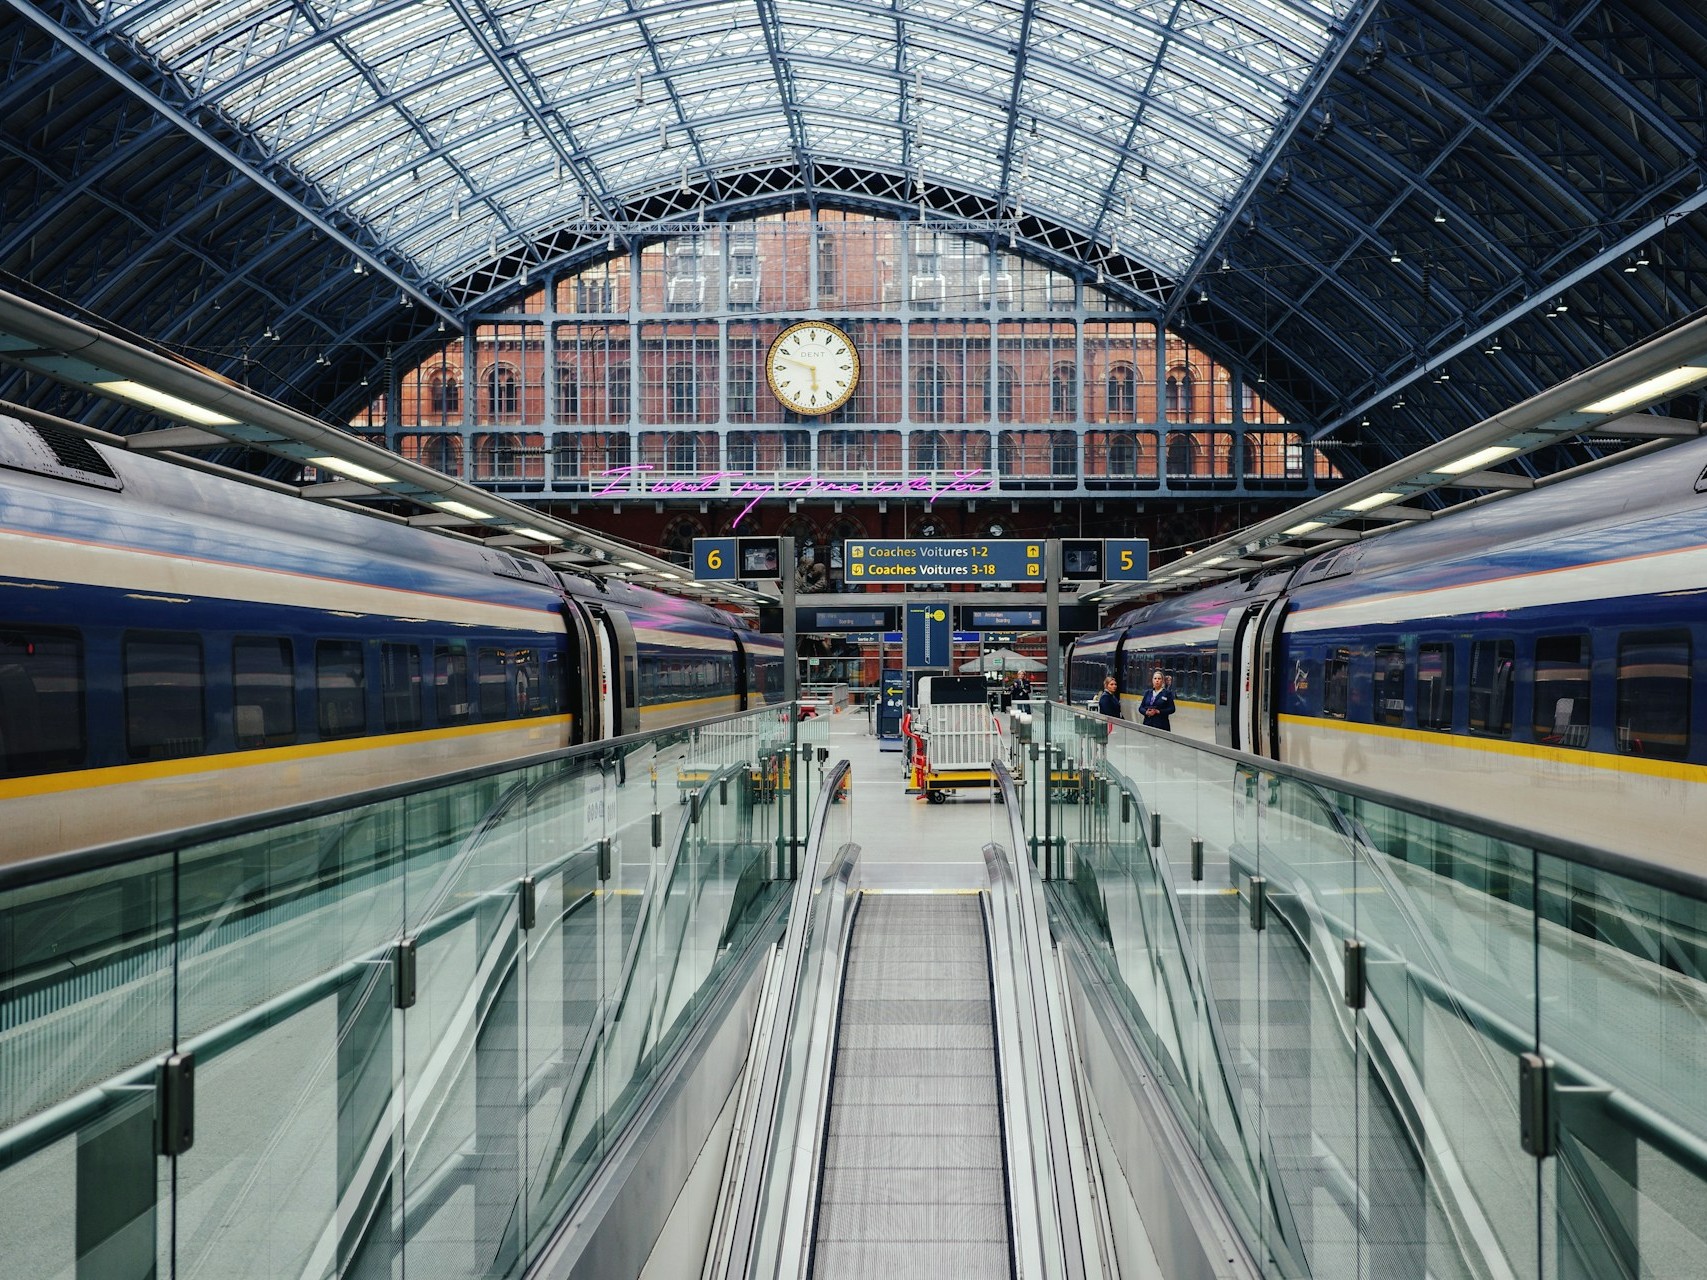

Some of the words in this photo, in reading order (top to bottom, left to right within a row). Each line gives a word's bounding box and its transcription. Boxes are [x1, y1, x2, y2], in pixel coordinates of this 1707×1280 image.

[592, 465, 654, 498] I
[707, 549, 722, 570] 6
[868, 546, 917, 557] Coaches
[919, 546, 969, 557] Voitures
[971, 546, 989, 557] 1-2
[1120, 550, 1134, 571] 5
[868, 564, 917, 575] Coaches
[919, 564, 969, 575] Voitures
[971, 564, 996, 575] 3-18
